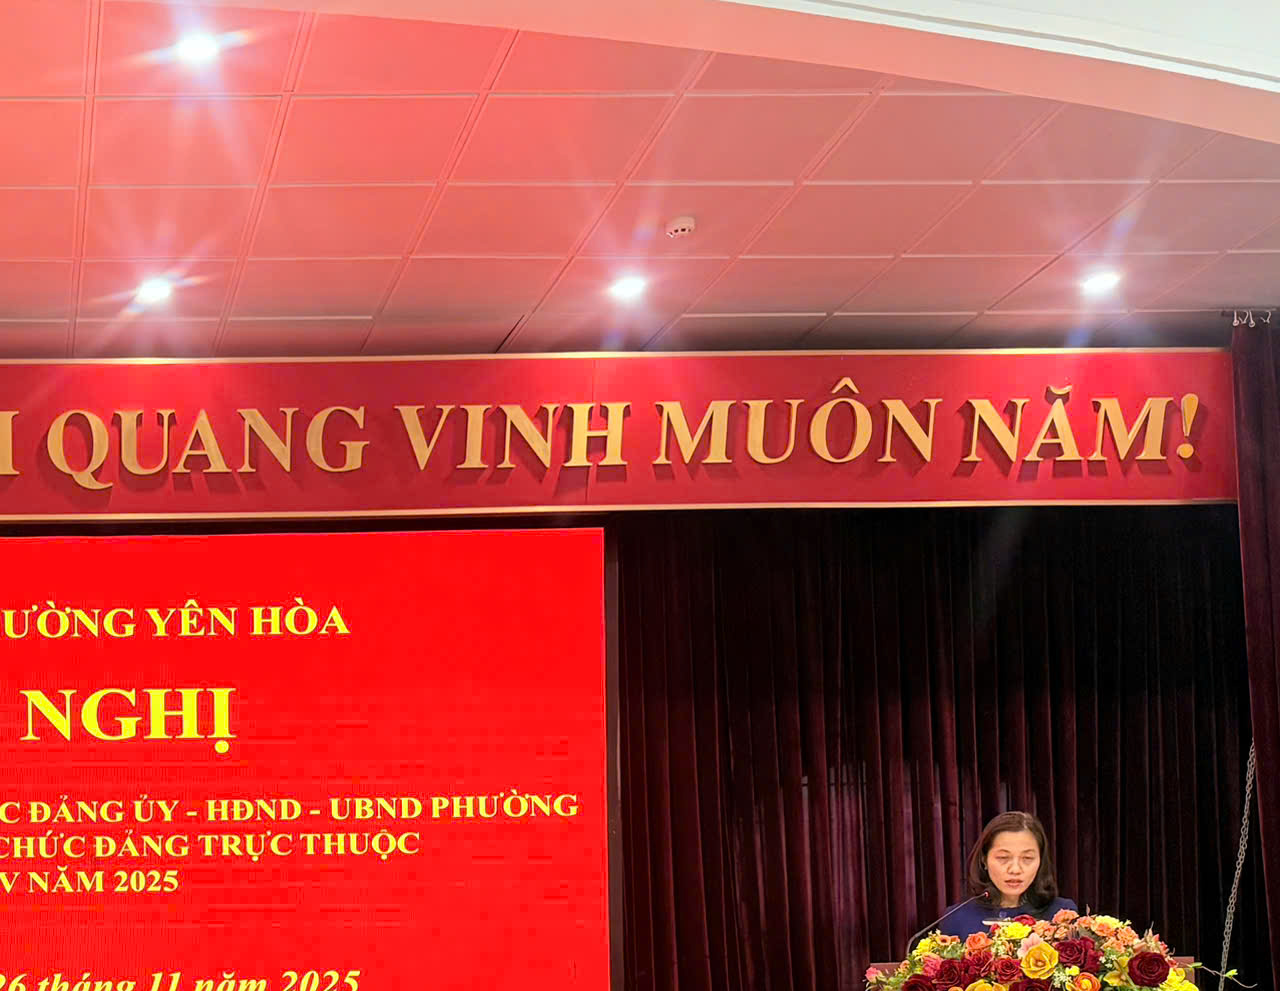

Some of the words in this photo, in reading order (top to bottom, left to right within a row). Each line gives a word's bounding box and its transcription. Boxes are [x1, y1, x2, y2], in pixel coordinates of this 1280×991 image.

[46, 406, 370, 491] QUANG
[392, 402, 631, 469] VINH
[656, 378, 942, 467] MUÔN
[962, 385, 1199, 462] NĂM!
[146, 599, 238, 637] YÊN
[250, 597, 351, 636] HÒA
[19, 687, 237, 754] NGHỊ
[28, 794, 125, 824] ĐẢNG
[133, 792, 179, 823] ỦY
[207, 798, 302, 822] HĐND
[330, 797, 423, 820] UBND
[431, 789, 579, 819] PHƯỜNG
[93, 829, 190, 858] ĐẢNG
[197, 831, 293, 862] TRỰC
[299, 829, 420, 861] THUỘC
[27, 866, 105, 893] NĂM
[114, 869, 179, 893] 2025
